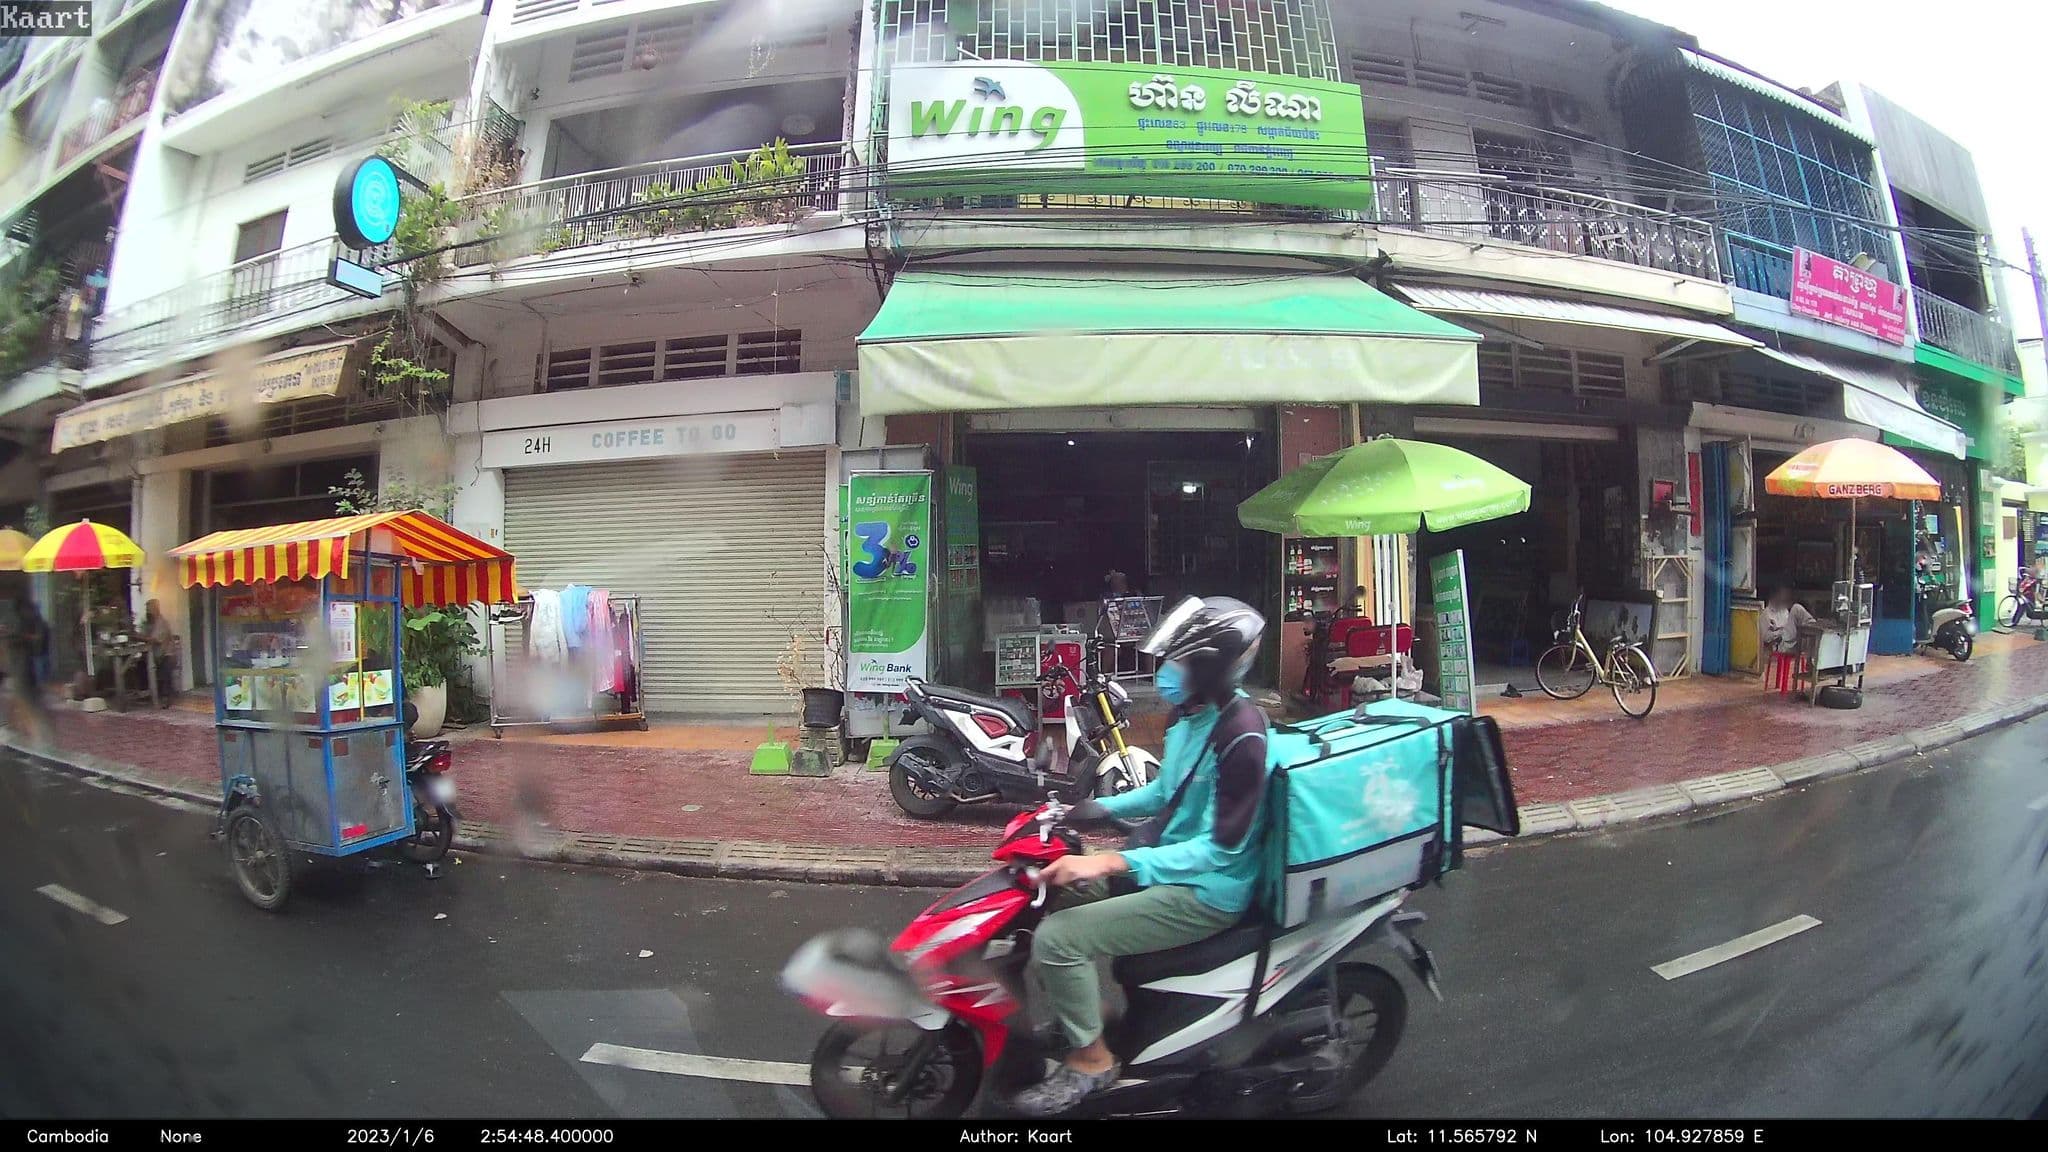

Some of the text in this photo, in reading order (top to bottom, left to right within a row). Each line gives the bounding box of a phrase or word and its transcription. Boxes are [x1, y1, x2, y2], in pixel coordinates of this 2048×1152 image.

[910, 98, 1068, 155] Wing
[524, 423, 737, 455] 24H COFFEE TO GO
[1828, 484, 1882, 497] GANZBERG
[1344, 519, 1372, 532] Wing
[860, 662, 912, 675] Wing Bank
